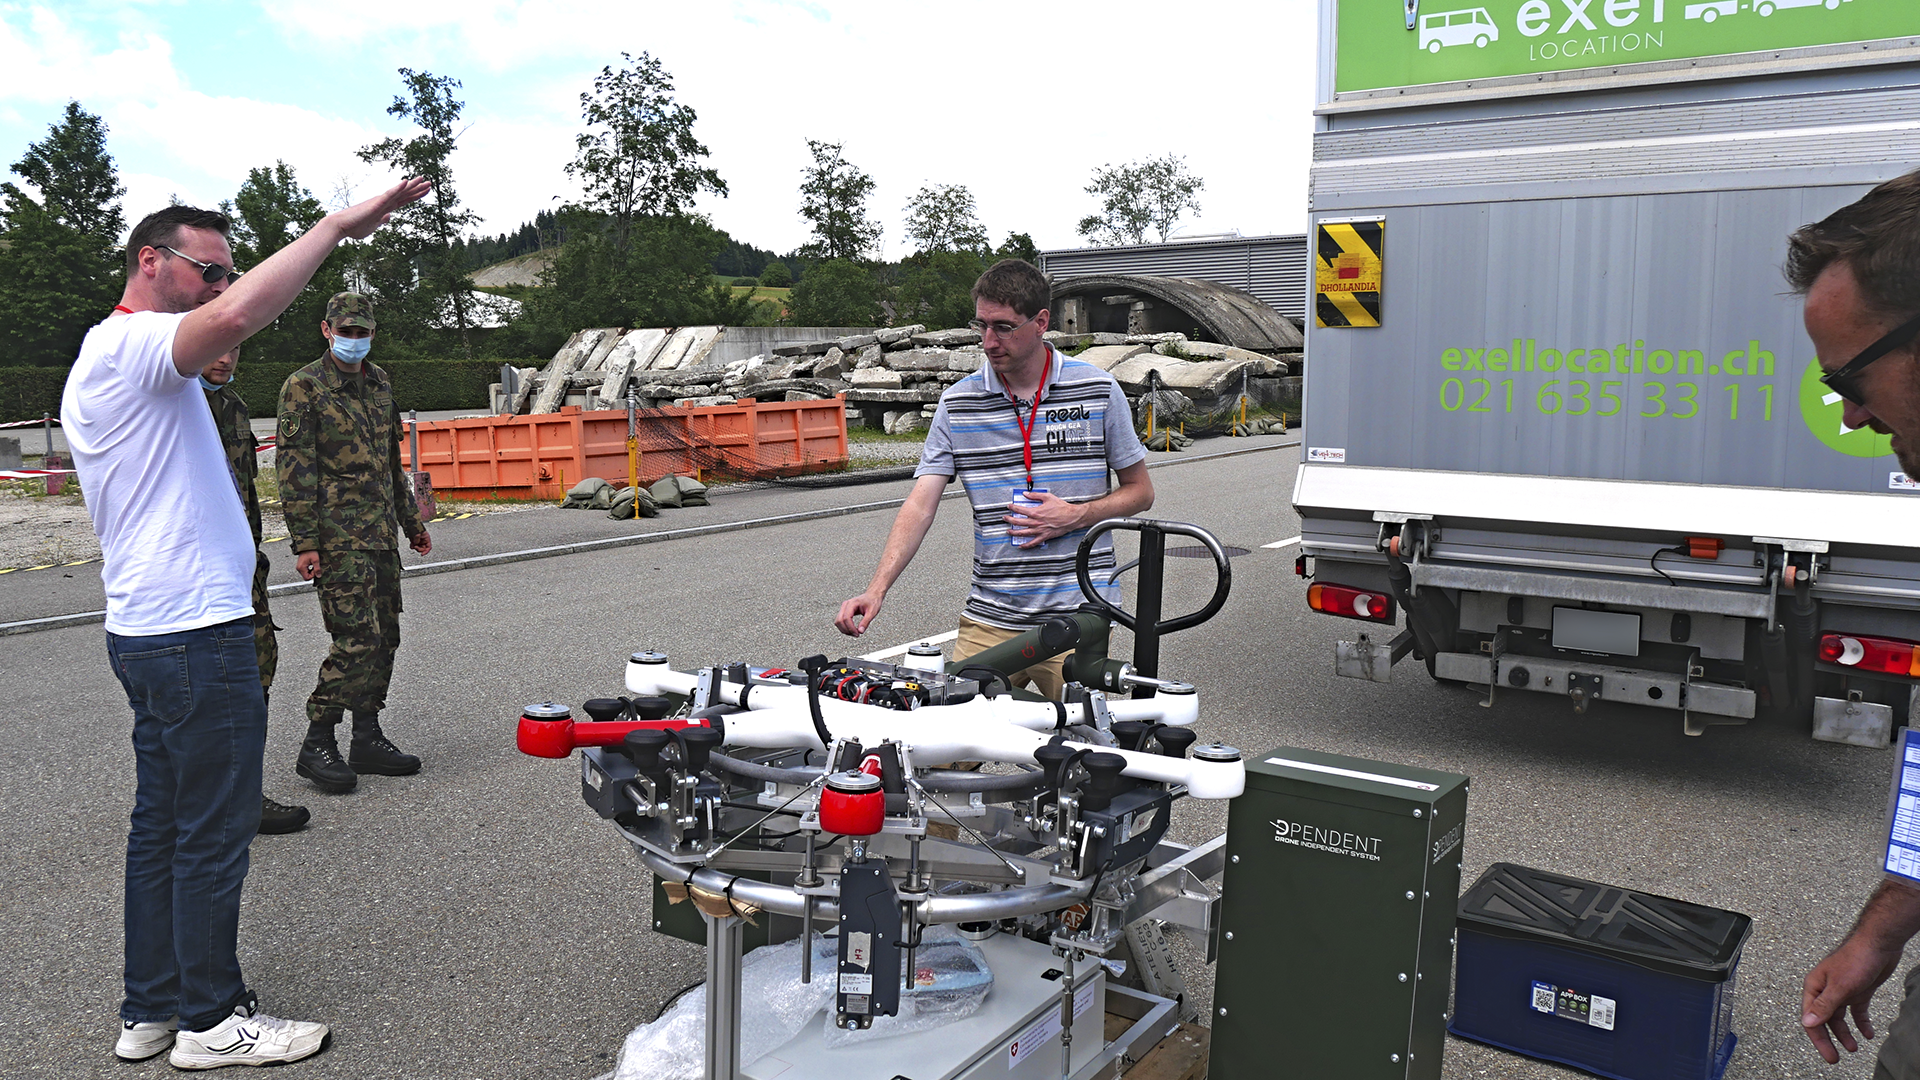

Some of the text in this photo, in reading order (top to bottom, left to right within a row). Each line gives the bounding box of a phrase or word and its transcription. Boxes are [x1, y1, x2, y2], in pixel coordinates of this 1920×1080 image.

[1530, 30, 1663, 61] LOCATION
[1320, 282, 1377, 292] DHOLLANDIA
[1440, 338, 1775, 376] exellocation.ch
[1439, 377, 1774, 421] 021 635 33 11
[1274, 835, 1380, 862] DRONE INDEPENDENT SYSTEM
[1135, 926, 1161, 980] ATELIER
[1560, 991, 1574, 999] APP
[1573, 993, 1588, 1003] BOX
